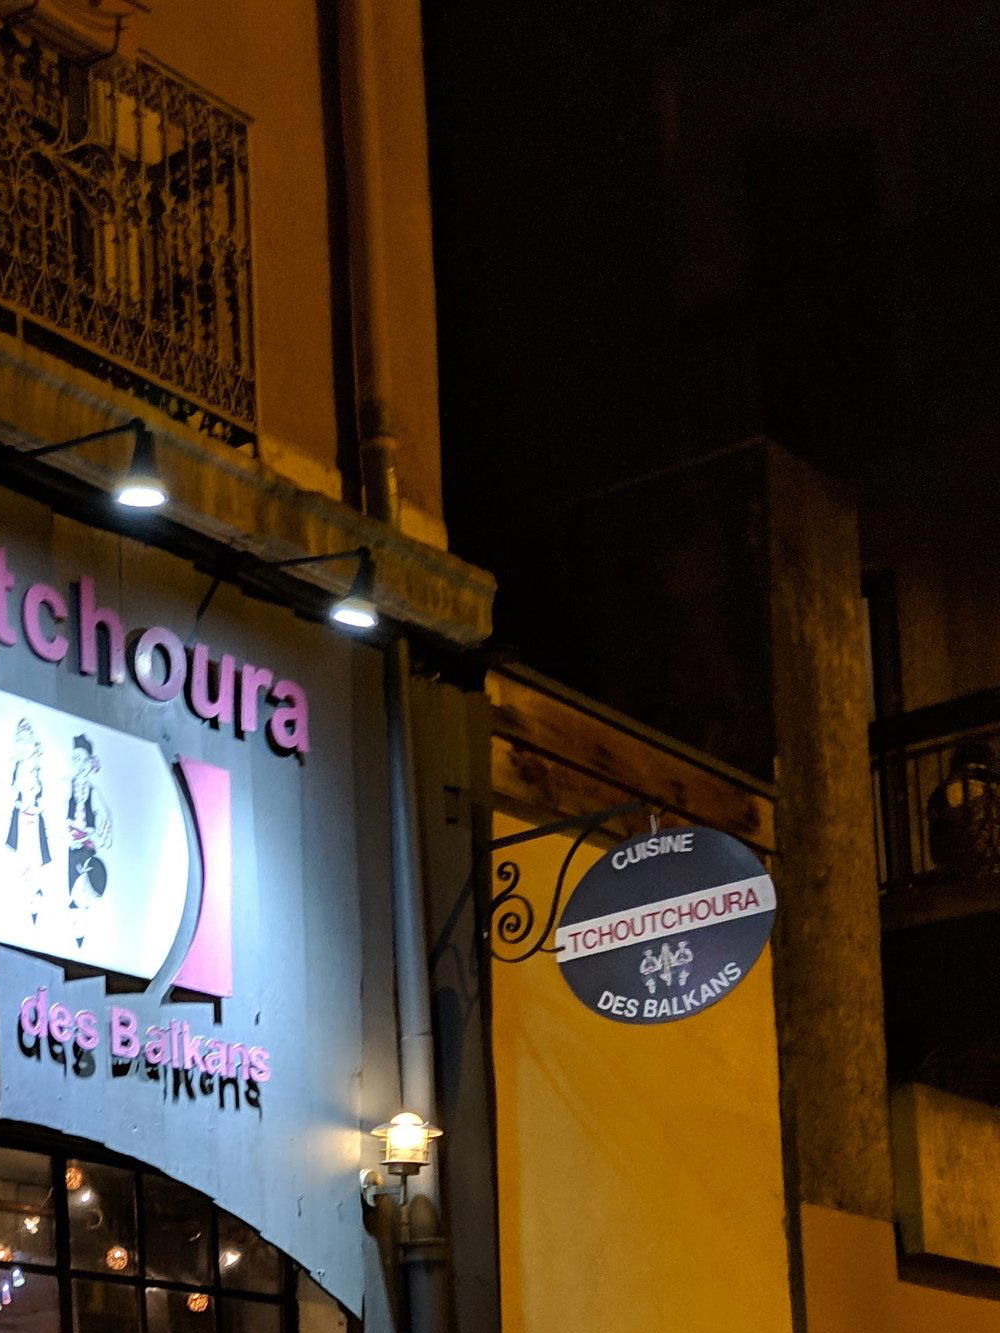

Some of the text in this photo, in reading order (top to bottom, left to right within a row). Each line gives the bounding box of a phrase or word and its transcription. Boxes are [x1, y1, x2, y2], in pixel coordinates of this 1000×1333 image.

[610, 832, 695, 870] CUISINE
[567, 887, 760, 954] TCHOUTCHOURA
[597, 961, 743, 1019] DES BALKANS
[20, 985, 101, 1050] des
[110, 1005, 272, 1084] Balkans
